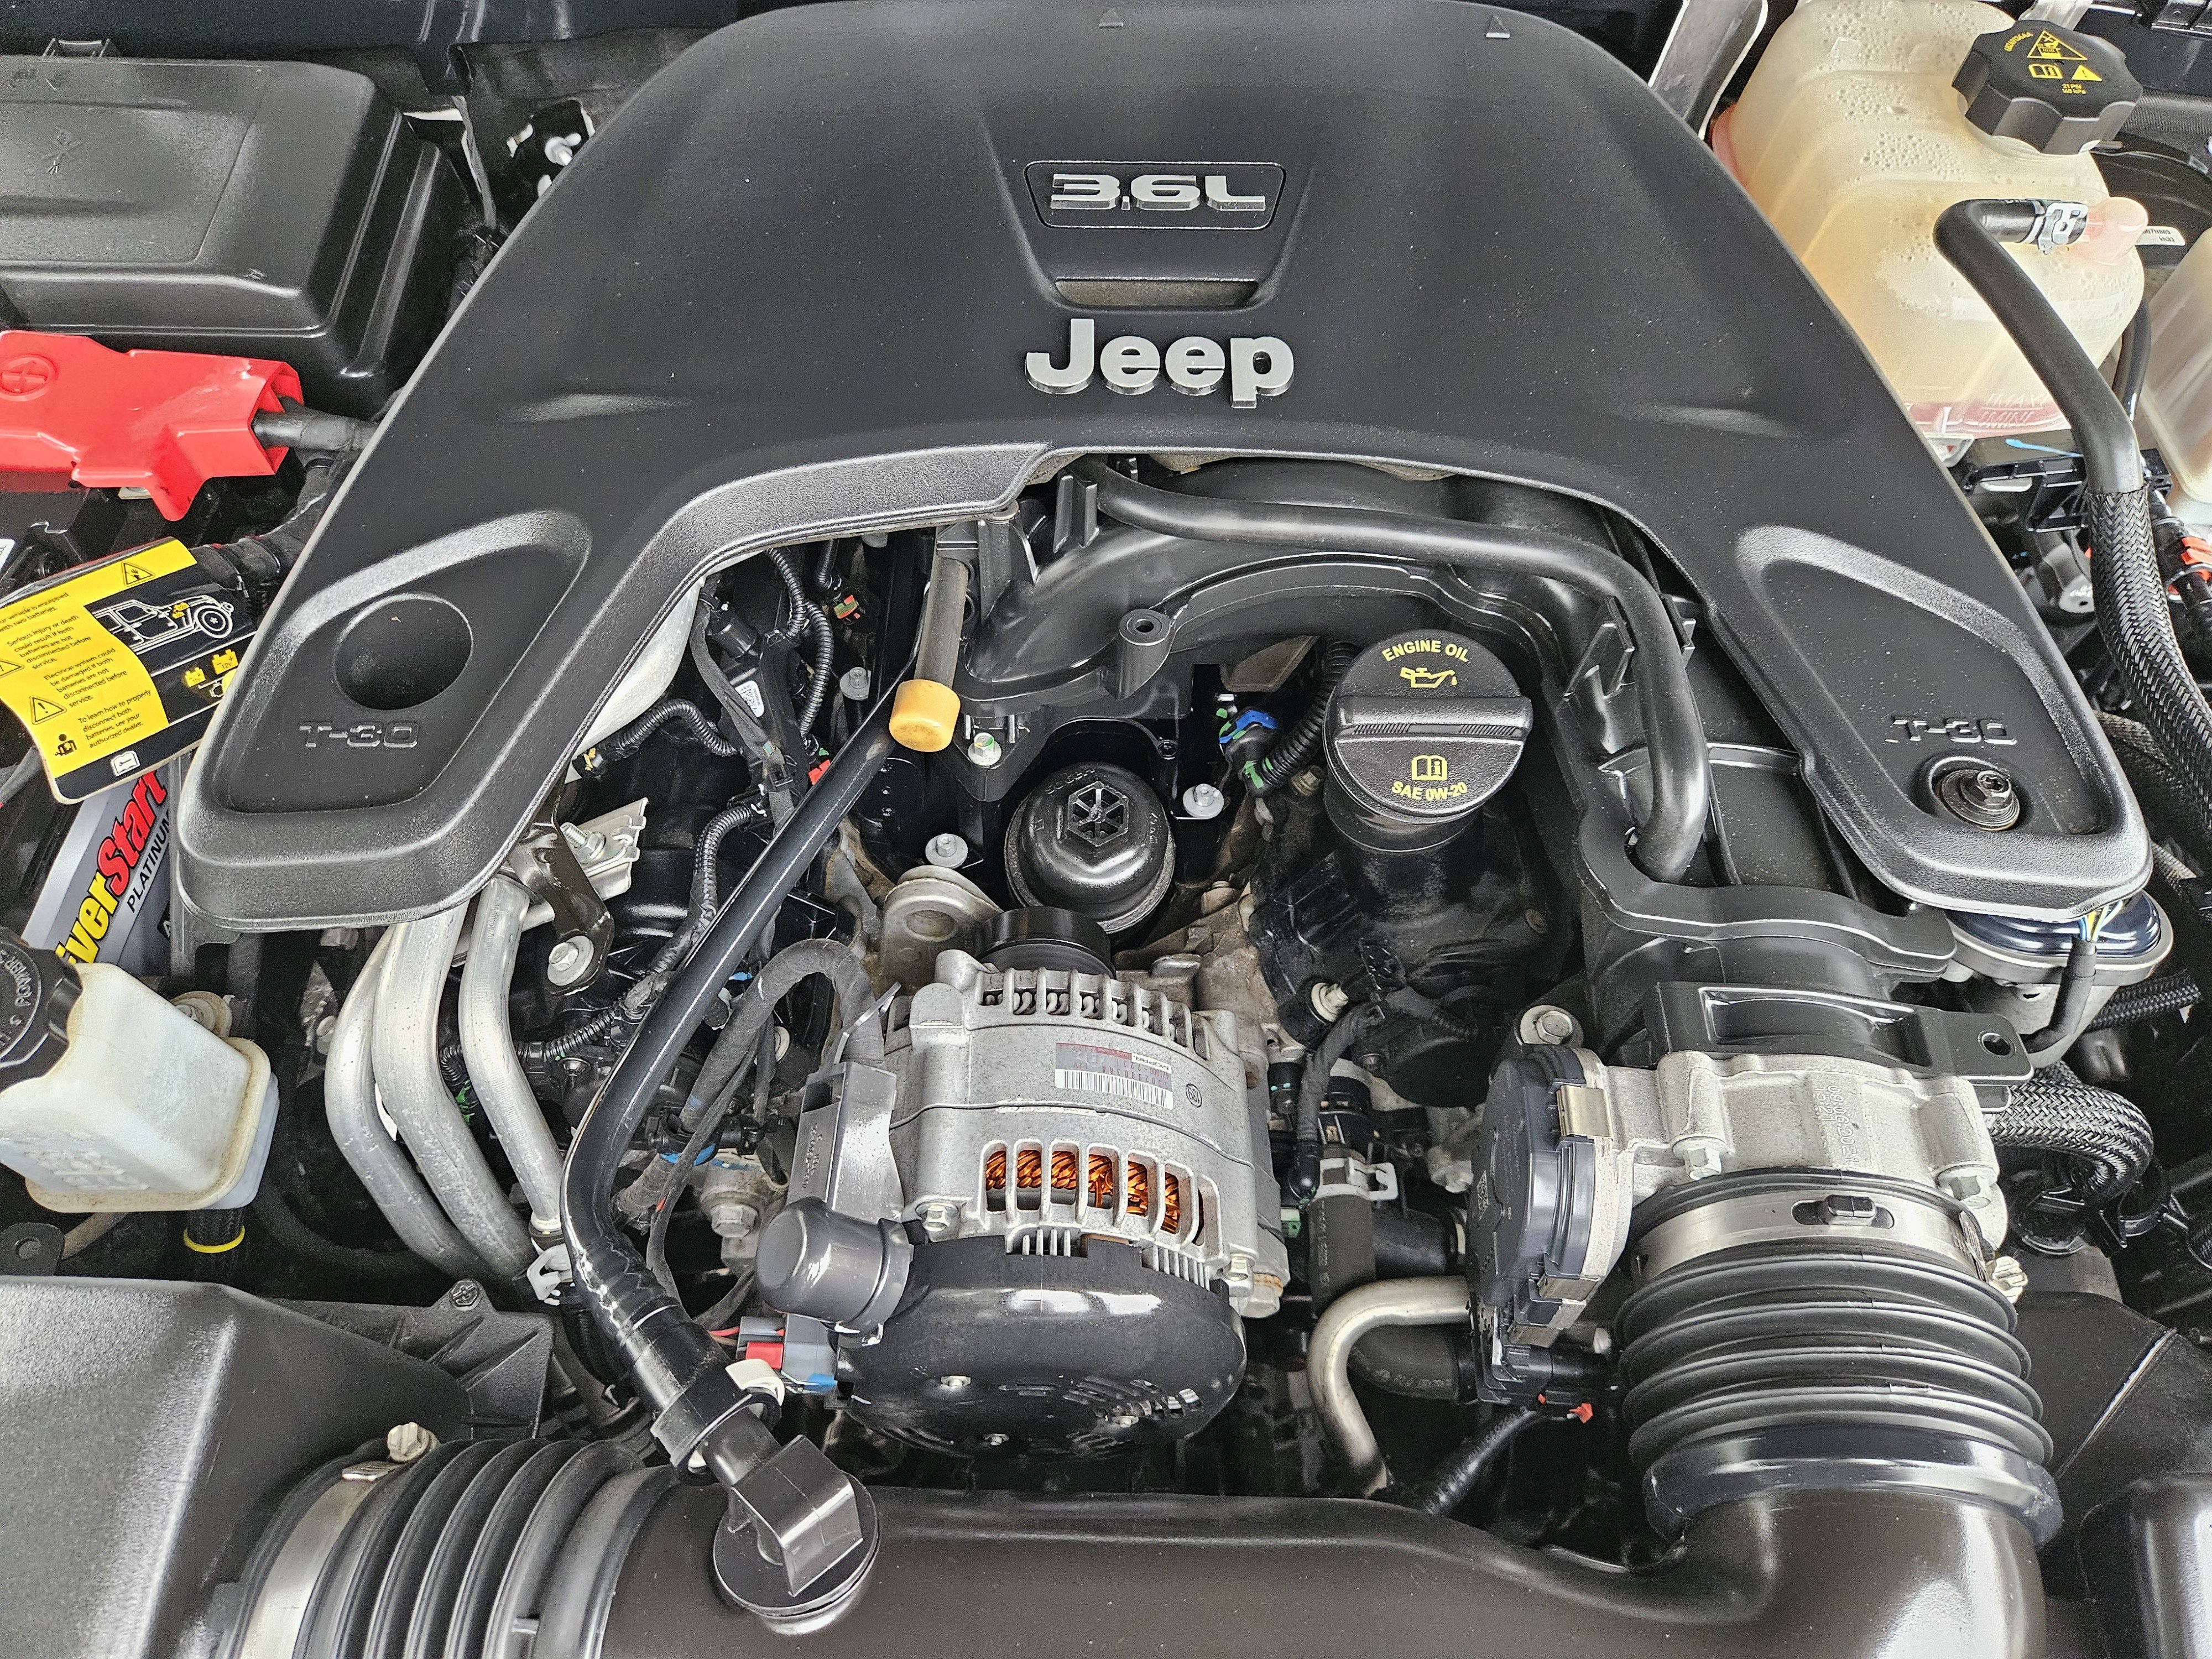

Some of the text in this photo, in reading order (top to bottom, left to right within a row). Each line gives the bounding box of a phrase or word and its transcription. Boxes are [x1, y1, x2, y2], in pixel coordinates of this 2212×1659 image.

[1050, 174, 1266, 211] 3.6L
[1025, 319, 1294, 409] Jeep
[7, 633, 33, 647] Serious
[33, 626, 51, 635] injury
[60, 615, 80, 625] death
[14, 641, 33, 652] could
[34, 634, 54, 644] result
[57, 626, 74, 635] both
[19, 644, 49, 658] batteries
[26, 637, 92, 664] disconnected before
[1382, 640, 1470, 664] ENGINE OIL
[44, 648, 116, 681] Electrical system could
[61, 666, 92, 682] damaged
[96, 657, 113, 666] both
[56, 678, 86, 692] batteries
[64, 671, 127, 700] disconnected before
[69, 695, 94, 708] service.
[87, 711, 104, 720] learn
[104, 705, 118, 713] how
[127, 690, 151, 705] properly
[83, 707, 132, 732] disconnect both
[126, 713, 140, 723] your
[1892, 716, 2017, 745] T-30
[90, 721, 143, 748] authorized dealer.
[299, 721, 419, 748] T-30
[1391, 781, 1468, 801] SAE 0W-20
